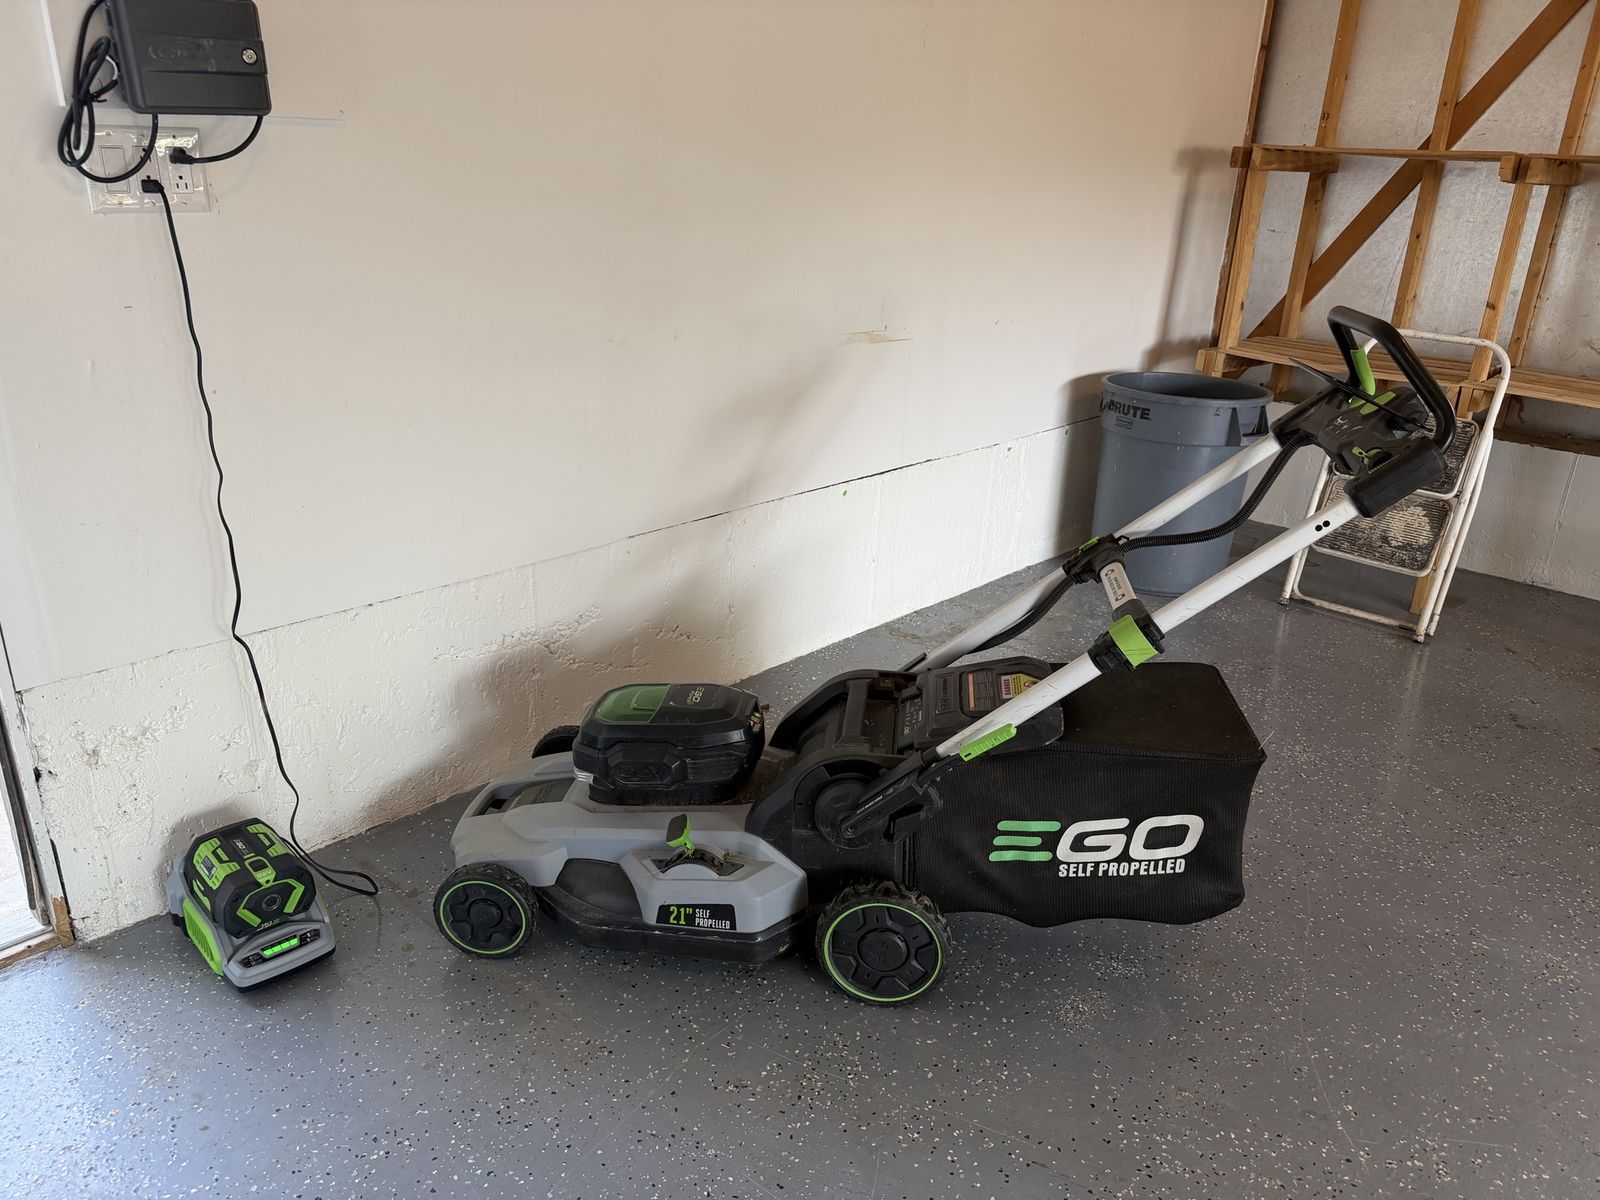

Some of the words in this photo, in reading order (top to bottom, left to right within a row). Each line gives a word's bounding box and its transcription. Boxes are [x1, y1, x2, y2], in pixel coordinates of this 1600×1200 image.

[988, 814, 1205, 863] EGO
[1058, 863, 1095, 878] SELF
[1098, 858, 1186, 876] PROPELLED
[669, 906, 693, 925] 21"
[695, 908, 711, 919] SELF
[695, 918, 731, 930] PROPELLED
